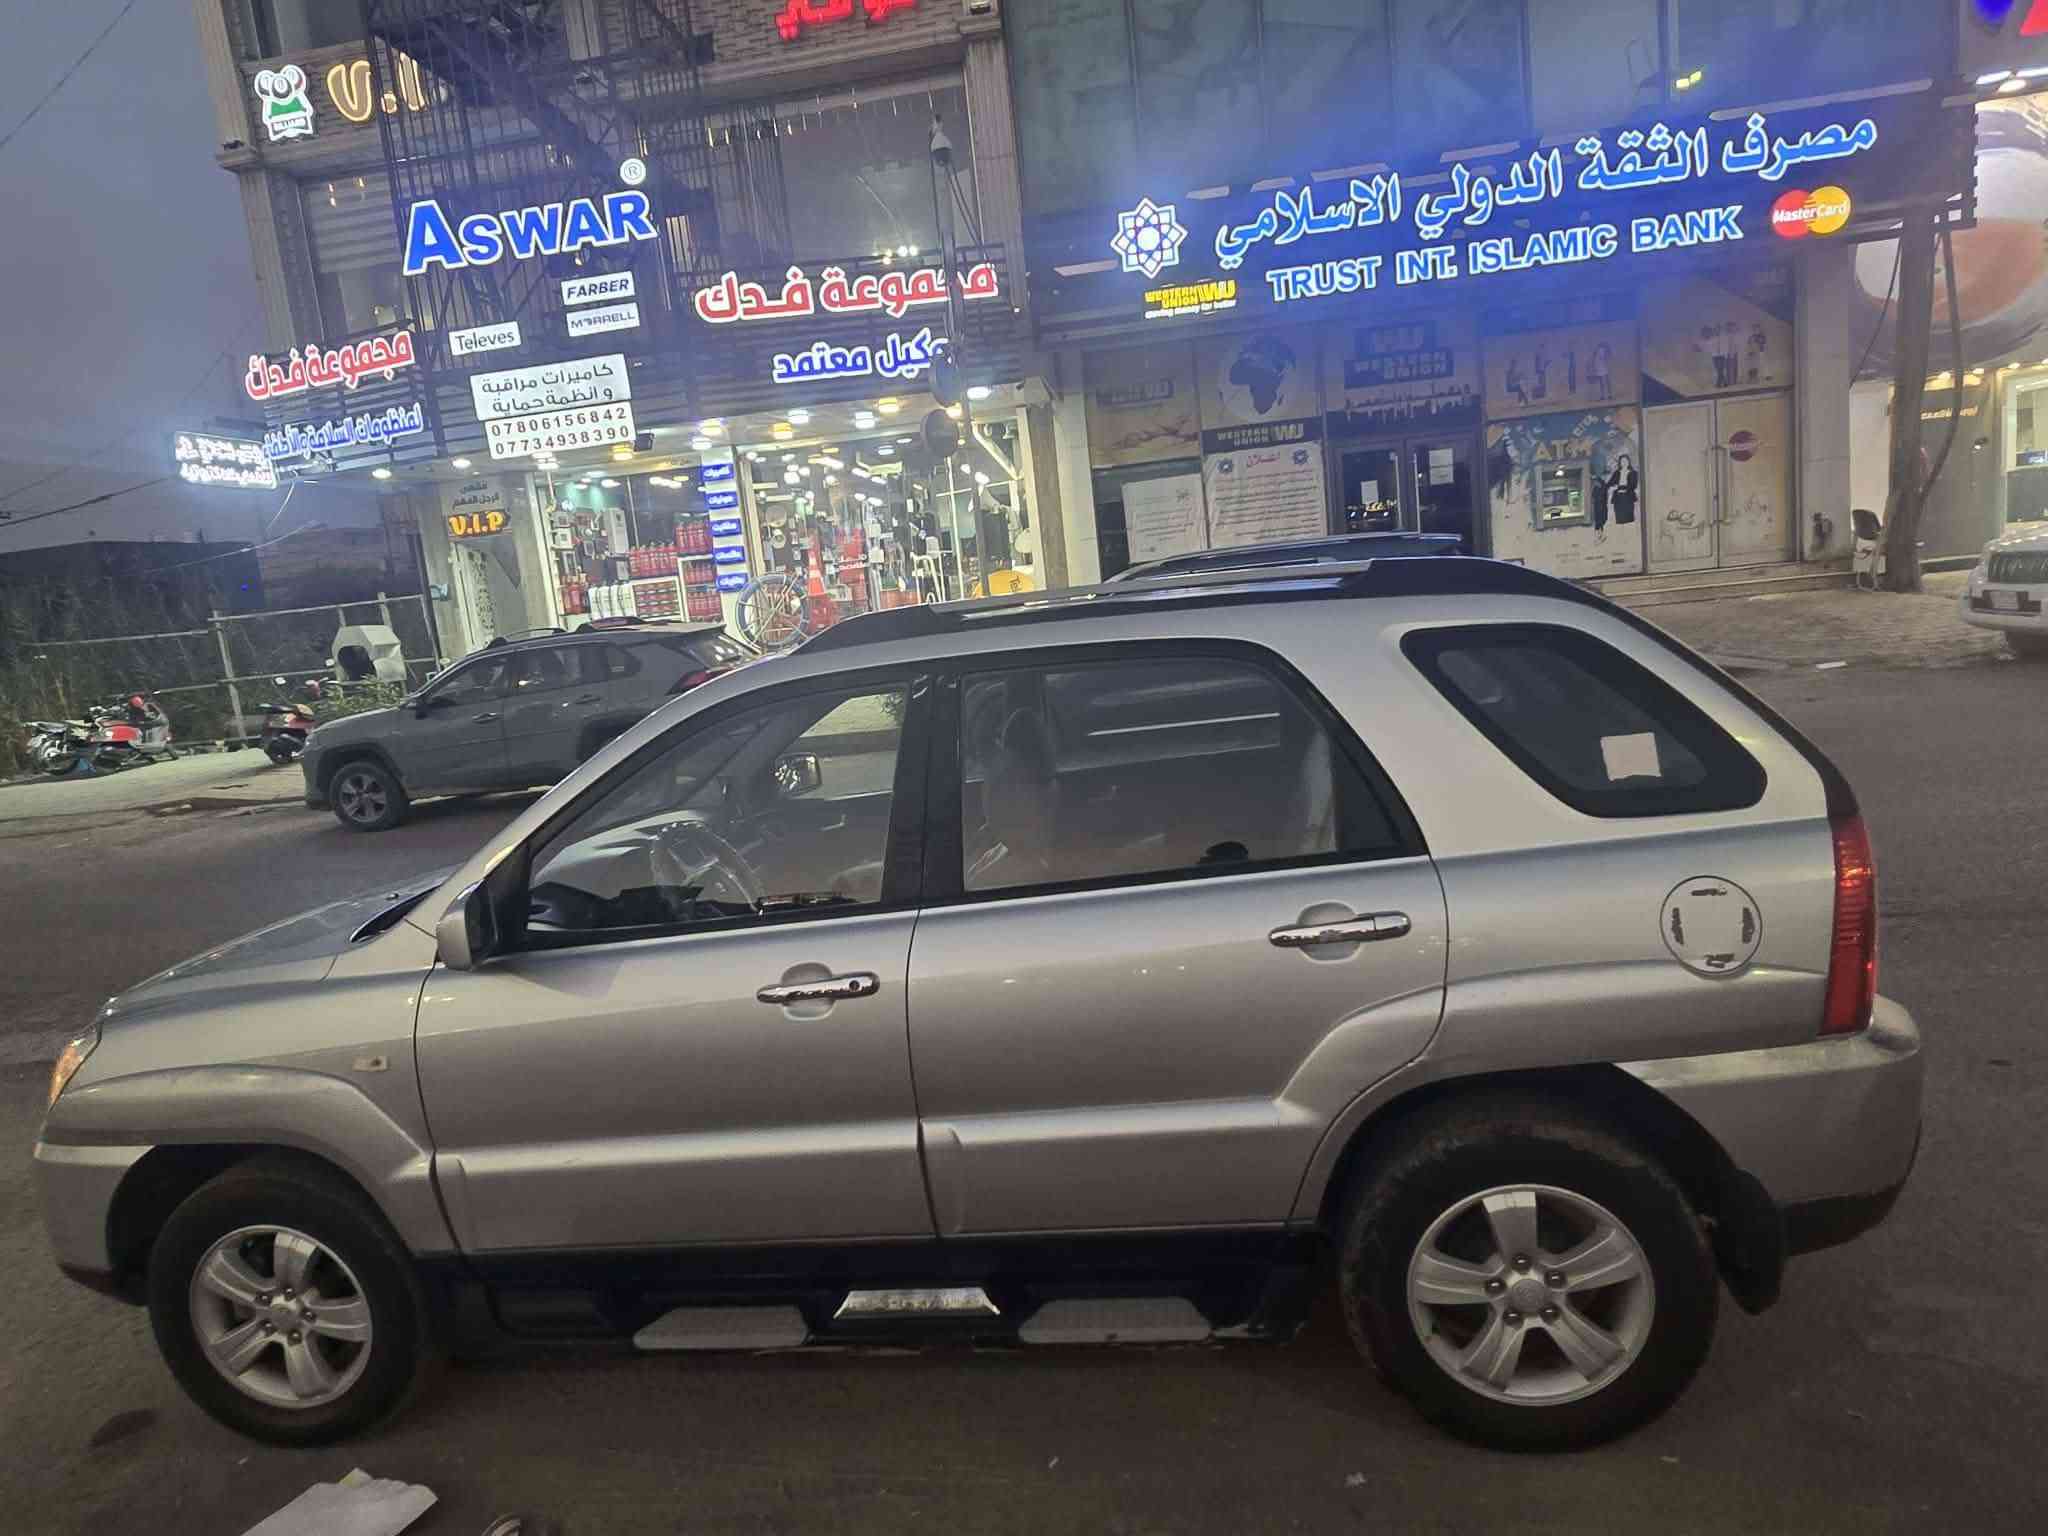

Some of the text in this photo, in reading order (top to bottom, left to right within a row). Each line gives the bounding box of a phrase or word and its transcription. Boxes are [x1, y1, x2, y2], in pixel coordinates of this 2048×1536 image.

[1215, 112, 1878, 270] مصرف الثقة الدولي الاسلامي
[1772, 203, 1847, 225] MasterCard
[1266, 204, 1745, 301] TRUST INT. ISLAMIC BANK
[567, 279, 630, 299] FARBER
[695, 262, 998, 323] مموعة فدك
[455, 329, 515, 351] Televes
[245, 331, 416, 400] مجموعة فدك
[773, 341, 872, 384] معتمد
[481, 362, 614, 396] كاميرات مراقبة
[492, 398, 545, 416] حماية
[492, 407, 627, 437] 07806156842
[495, 425, 629, 455] 07734938390
[448, 511, 504, 536] V.I.P
